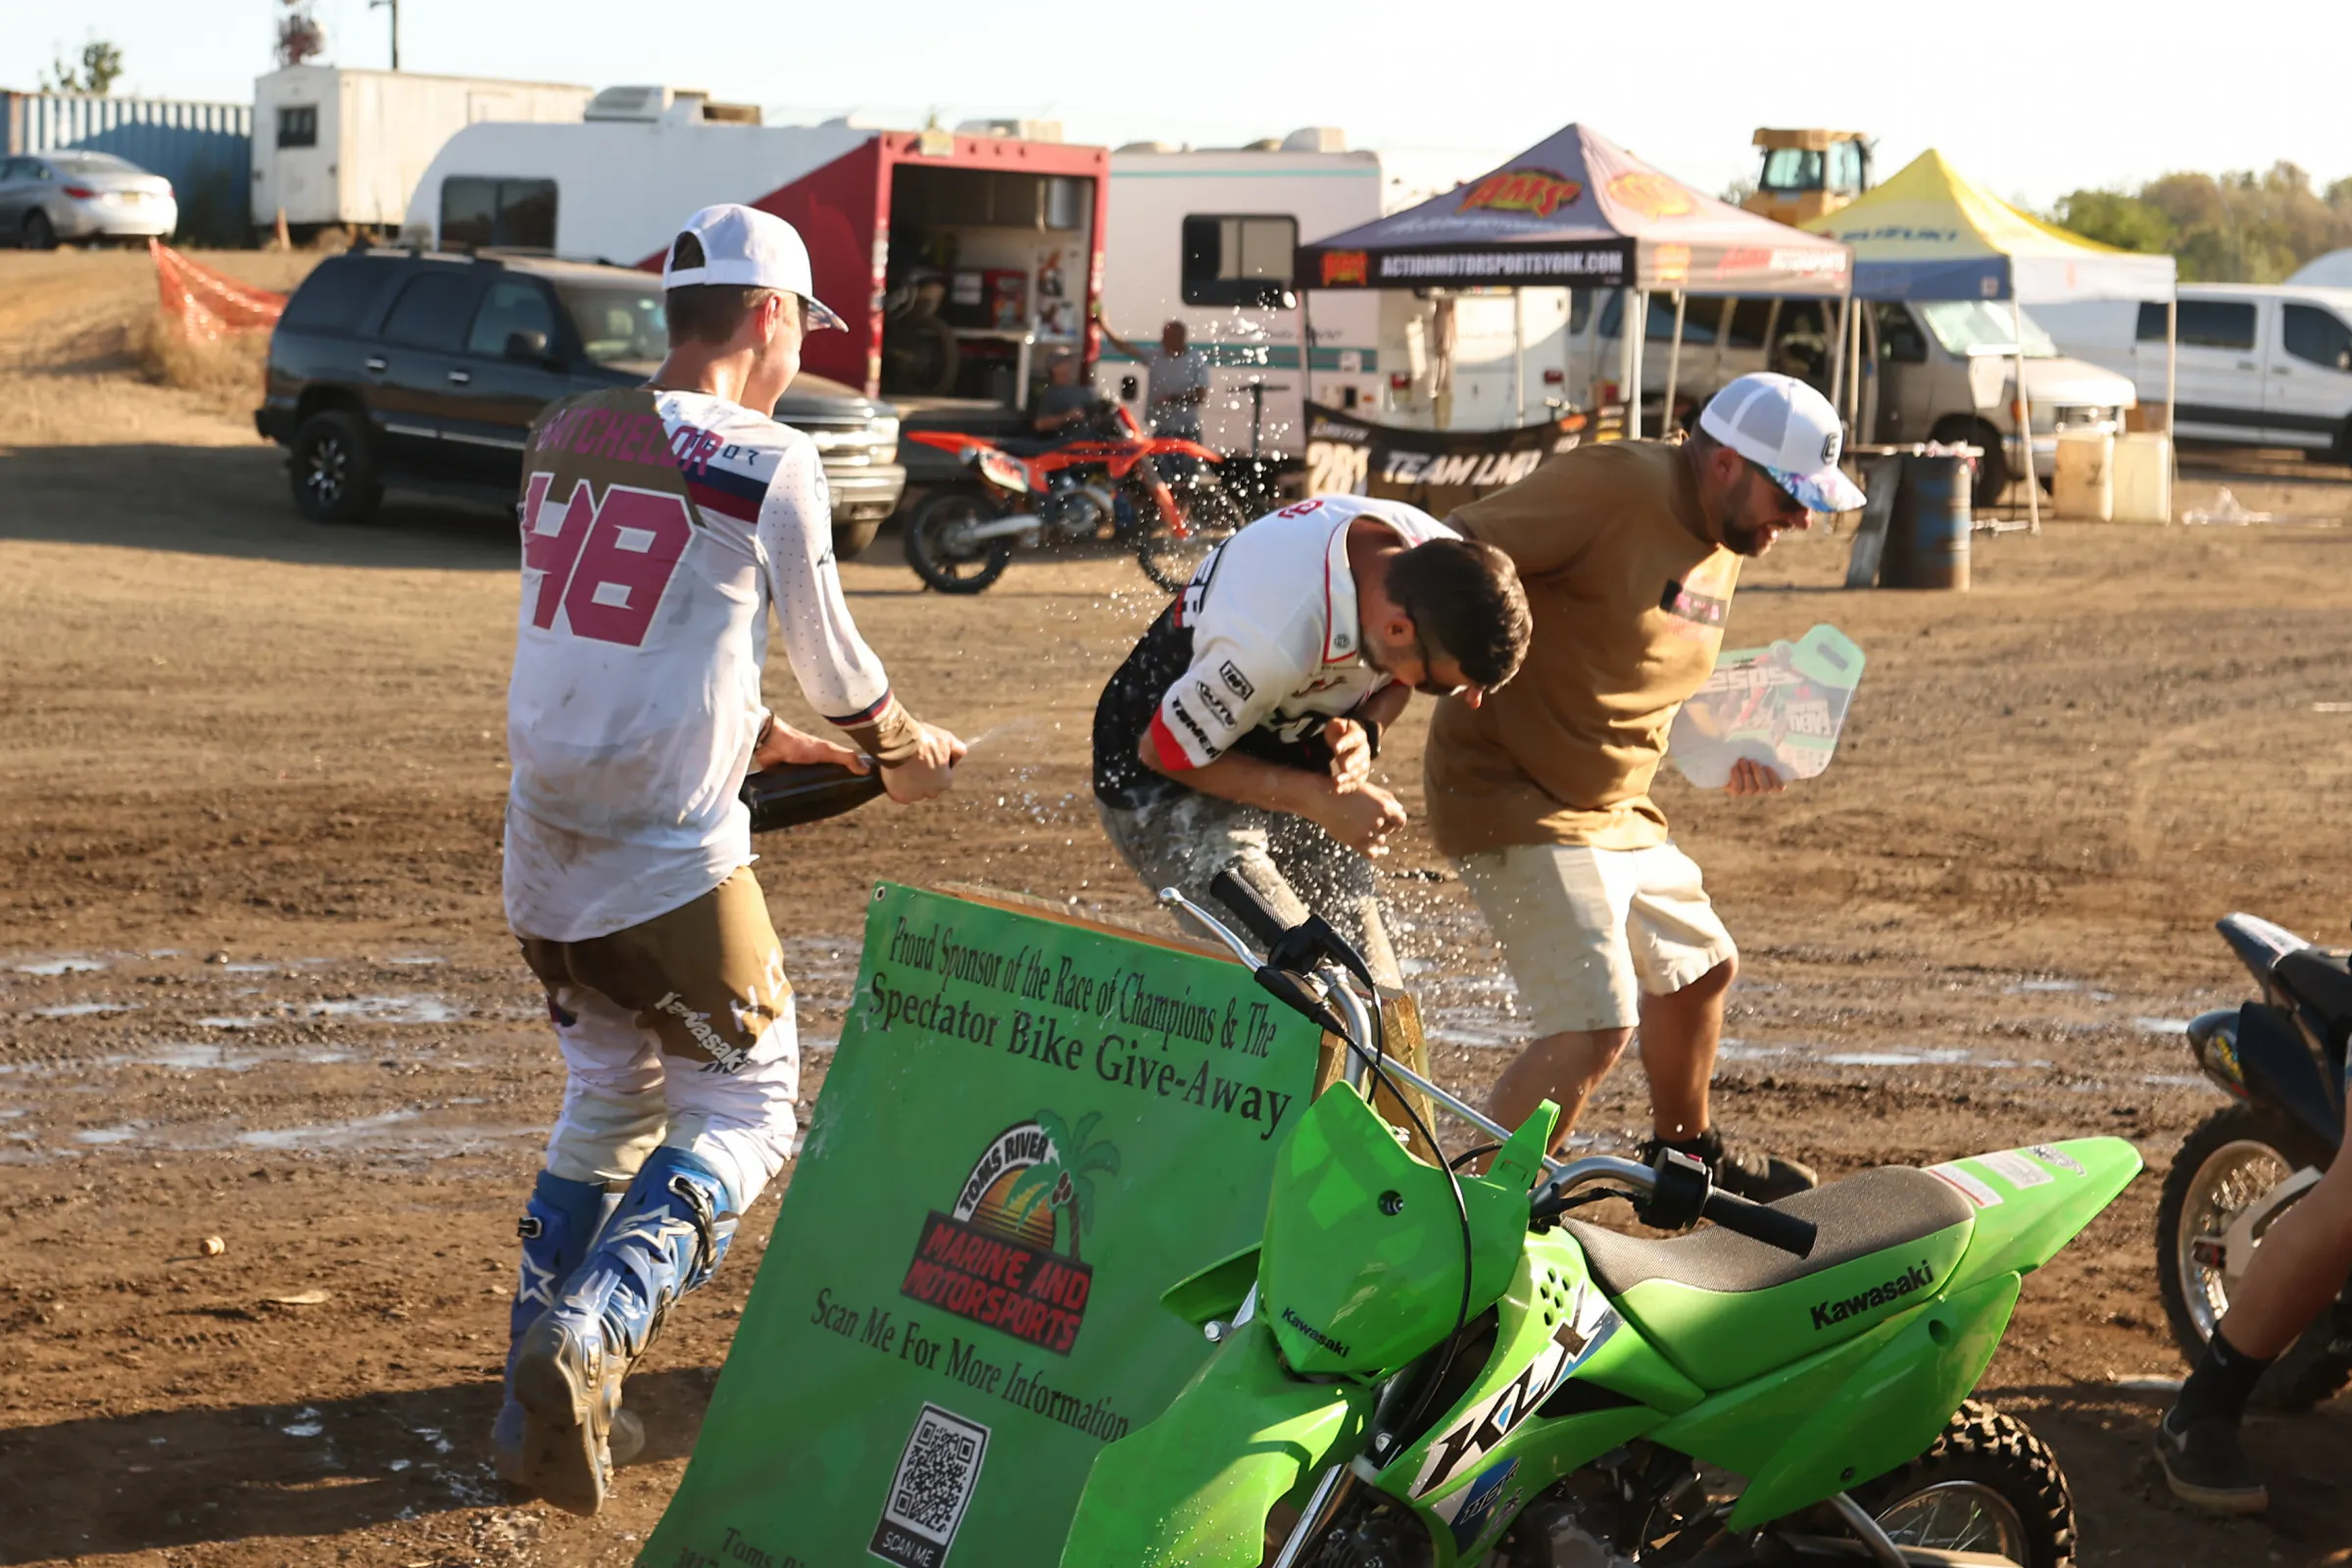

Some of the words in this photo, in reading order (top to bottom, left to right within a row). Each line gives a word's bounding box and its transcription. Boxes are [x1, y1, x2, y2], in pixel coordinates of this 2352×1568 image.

[1383, 450, 1476, 486] TEAM
[522, 471, 697, 648] 48
[889, 915, 939, 971] Proud
[941, 927, 1000, 993] Sponsor
[1002, 945, 1030, 992] of
[1025, 948, 1050, 1001] the
[1054, 956, 1094, 1011] Race
[1097, 966, 1122, 1017] of
[1118, 971, 1215, 1052] Champions
[1221, 996, 1237, 1050] &
[1242, 1001, 1277, 1058] The
[868, 971, 1001, 1047] Spectator
[1007, 1009, 1084, 1070] Bike
[1095, 1034, 1293, 1141] Give-Away
[958, 1147, 1003, 1213] TOMS
[1004, 1131, 1049, 1164] RIVER
[901, 1258, 1082, 1351] MOTORSPORTS
[923, 1222, 1030, 1289] MARINE
[1028, 1261, 1091, 1310] AND
[1810, 1258, 1936, 1331] Kawasaki
[810, 1287, 859, 1338] Scan
[858, 1306, 897, 1352] Me
[899, 1321, 941, 1371] For
[944, 1337, 1003, 1394] More
[1001, 1361, 1130, 1443] Information
[1282, 1306, 1350, 1358] Kawasaki
[882, 1530, 918, 1558] SCAN
[914, 1544, 936, 1568] ME
